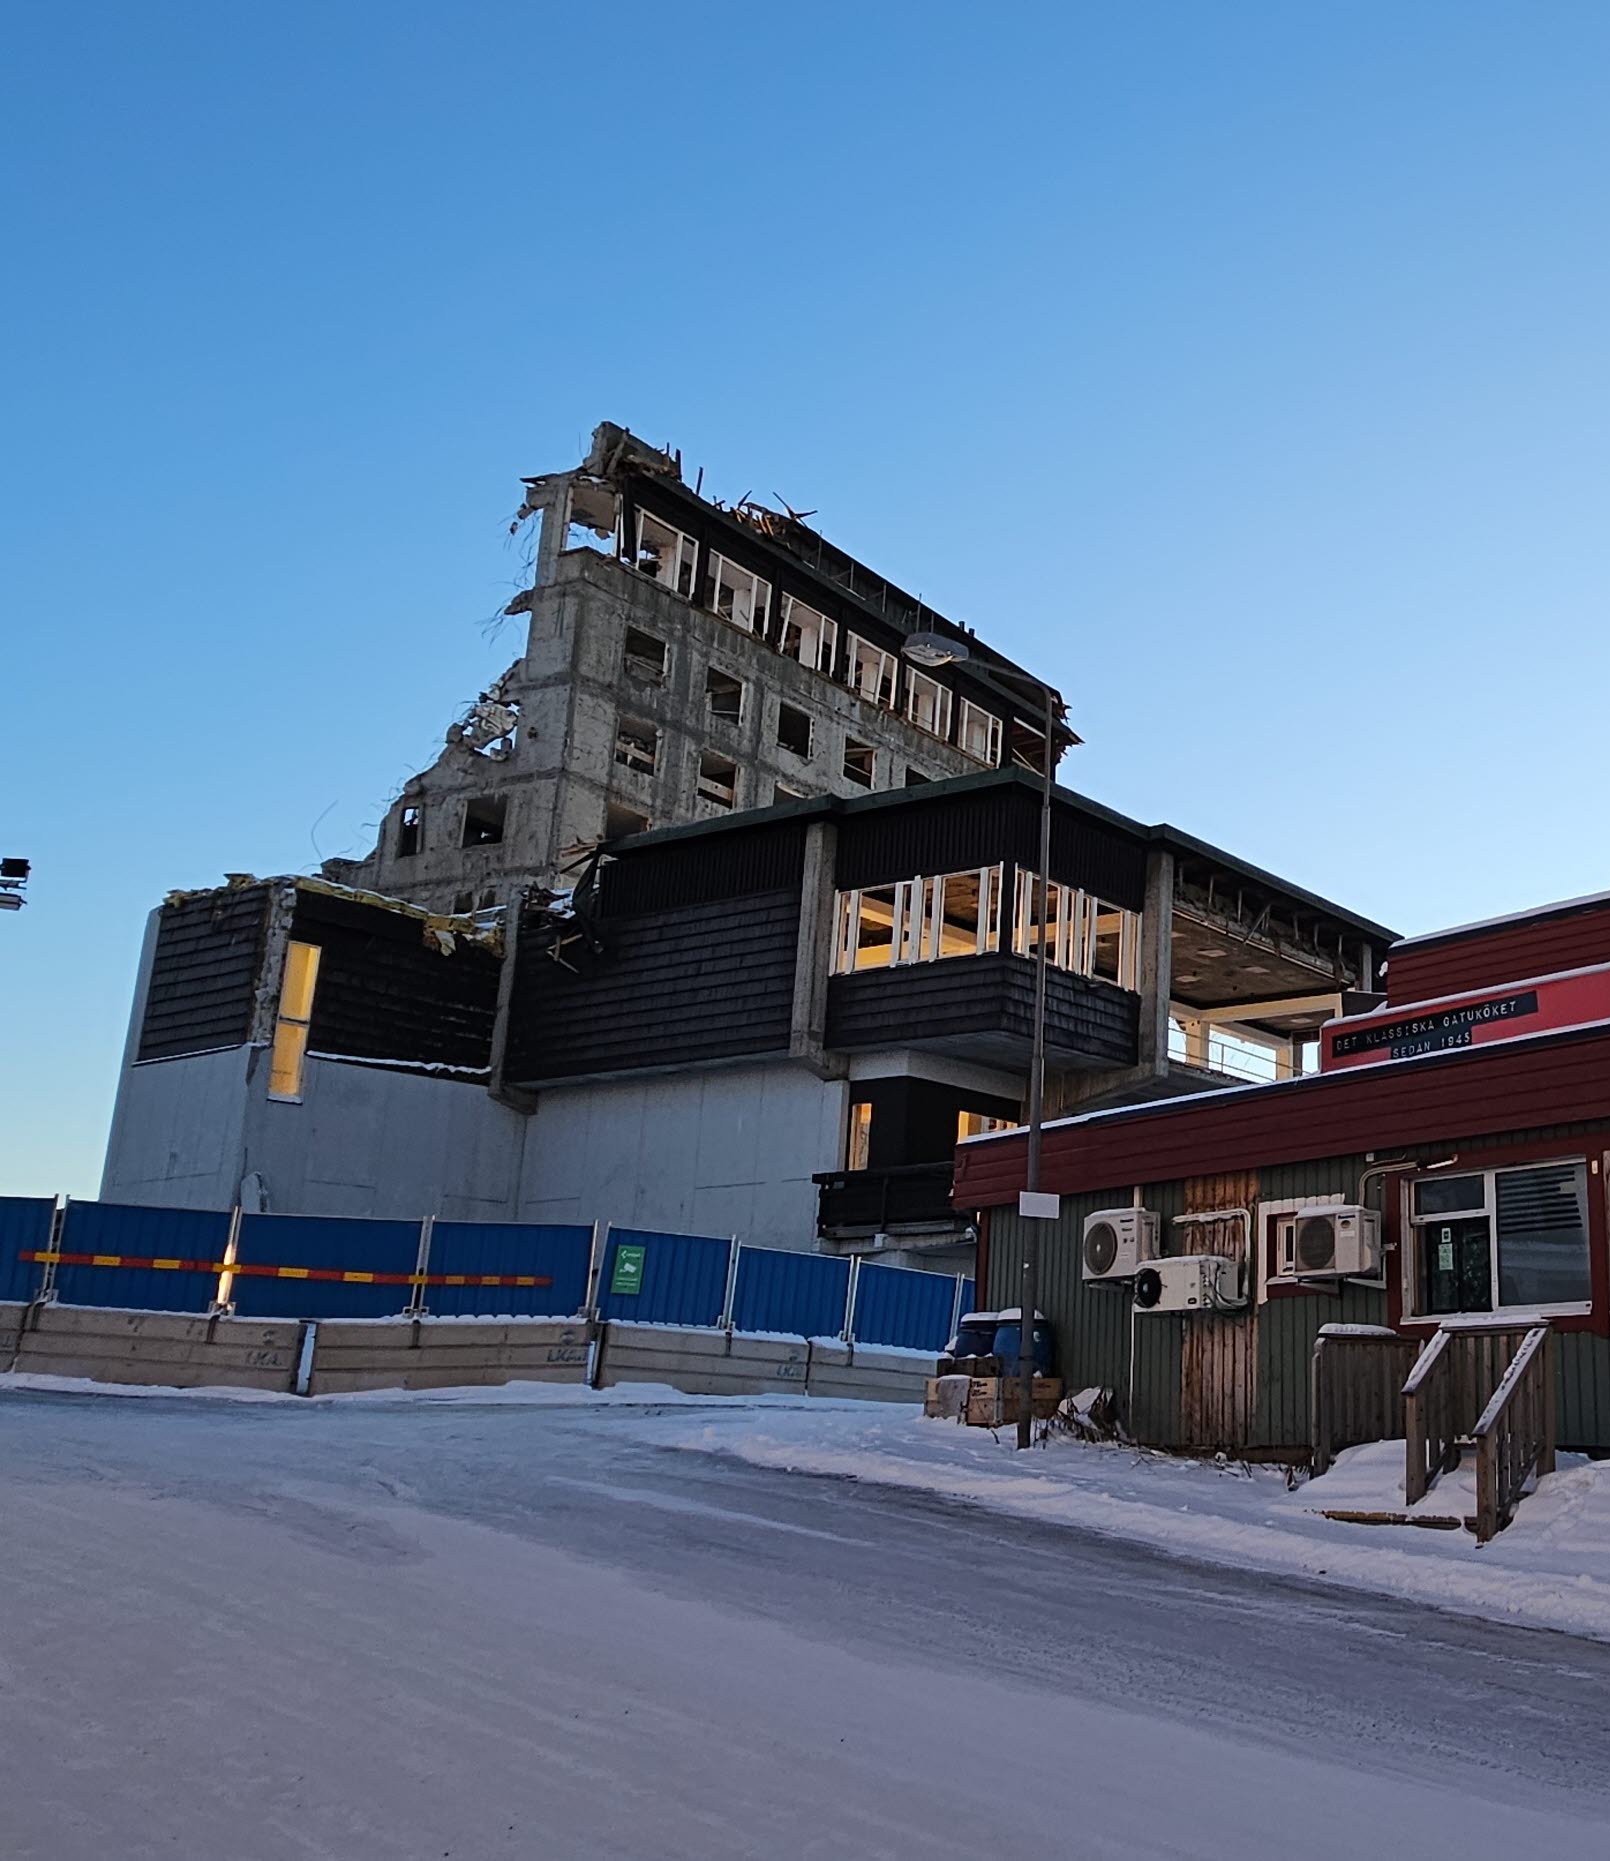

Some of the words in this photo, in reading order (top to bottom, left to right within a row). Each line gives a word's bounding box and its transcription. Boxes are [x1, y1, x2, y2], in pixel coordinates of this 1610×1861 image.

[1336, 1036, 1357, 1051] DET
[1365, 1020, 1435, 1045] KLASSISKA
[1442, 1001, 1516, 1027] GATUKÖKET
[1392, 1041, 1431, 1058] SEDAN
[1441, 1031, 1470, 1048] 1945
